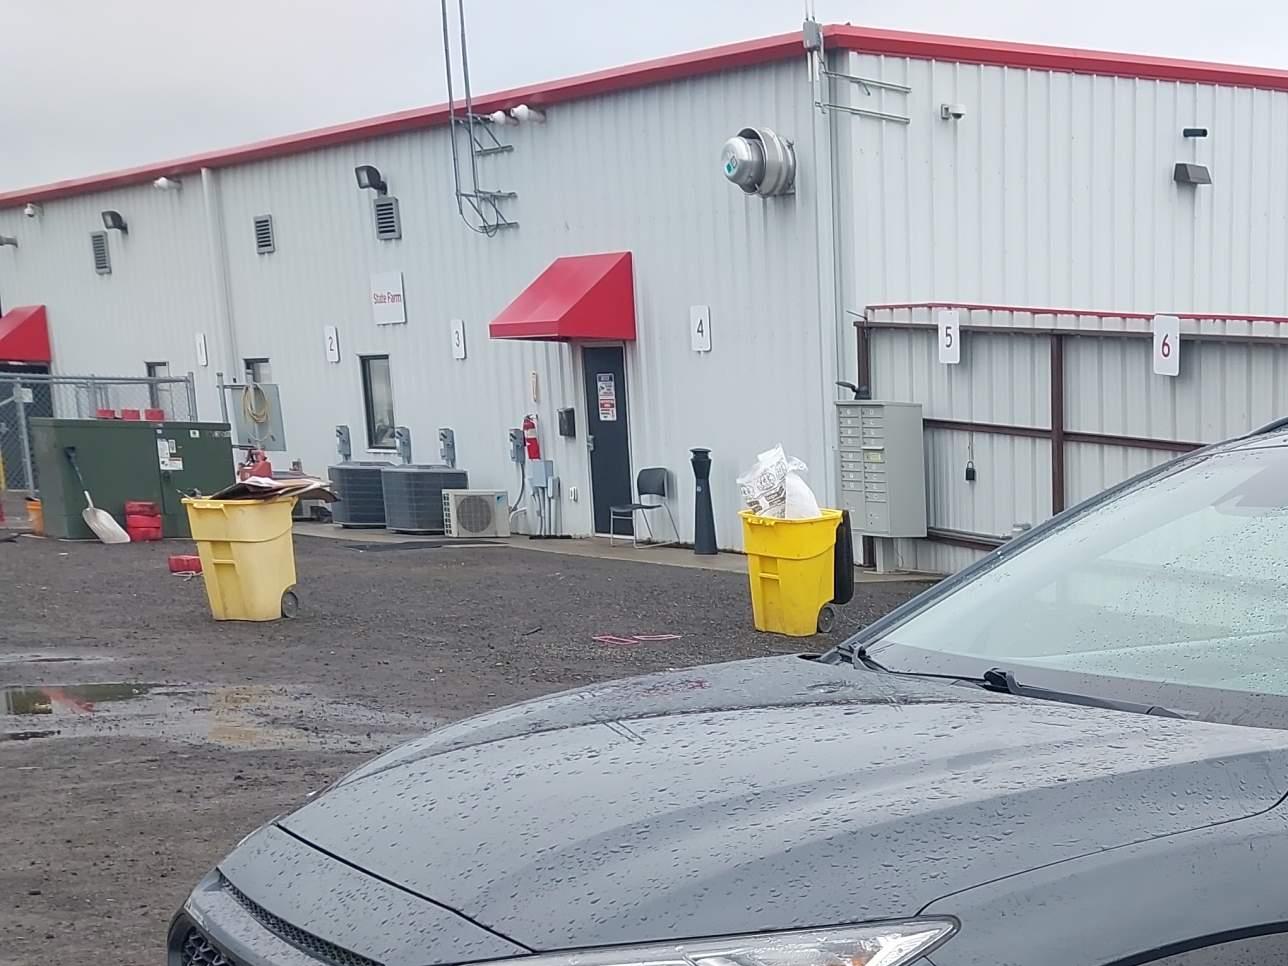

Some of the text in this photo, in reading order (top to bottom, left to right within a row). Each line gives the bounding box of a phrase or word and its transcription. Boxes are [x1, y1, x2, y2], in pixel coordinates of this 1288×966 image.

[387, 291, 401, 304] Farm
[696, 319, 704, 338] 4
[945, 326, 953, 348] 5
[328, 335, 335, 352] 2
[454, 330, 460, 348] 3
[1161, 333, 1171, 358] 6
